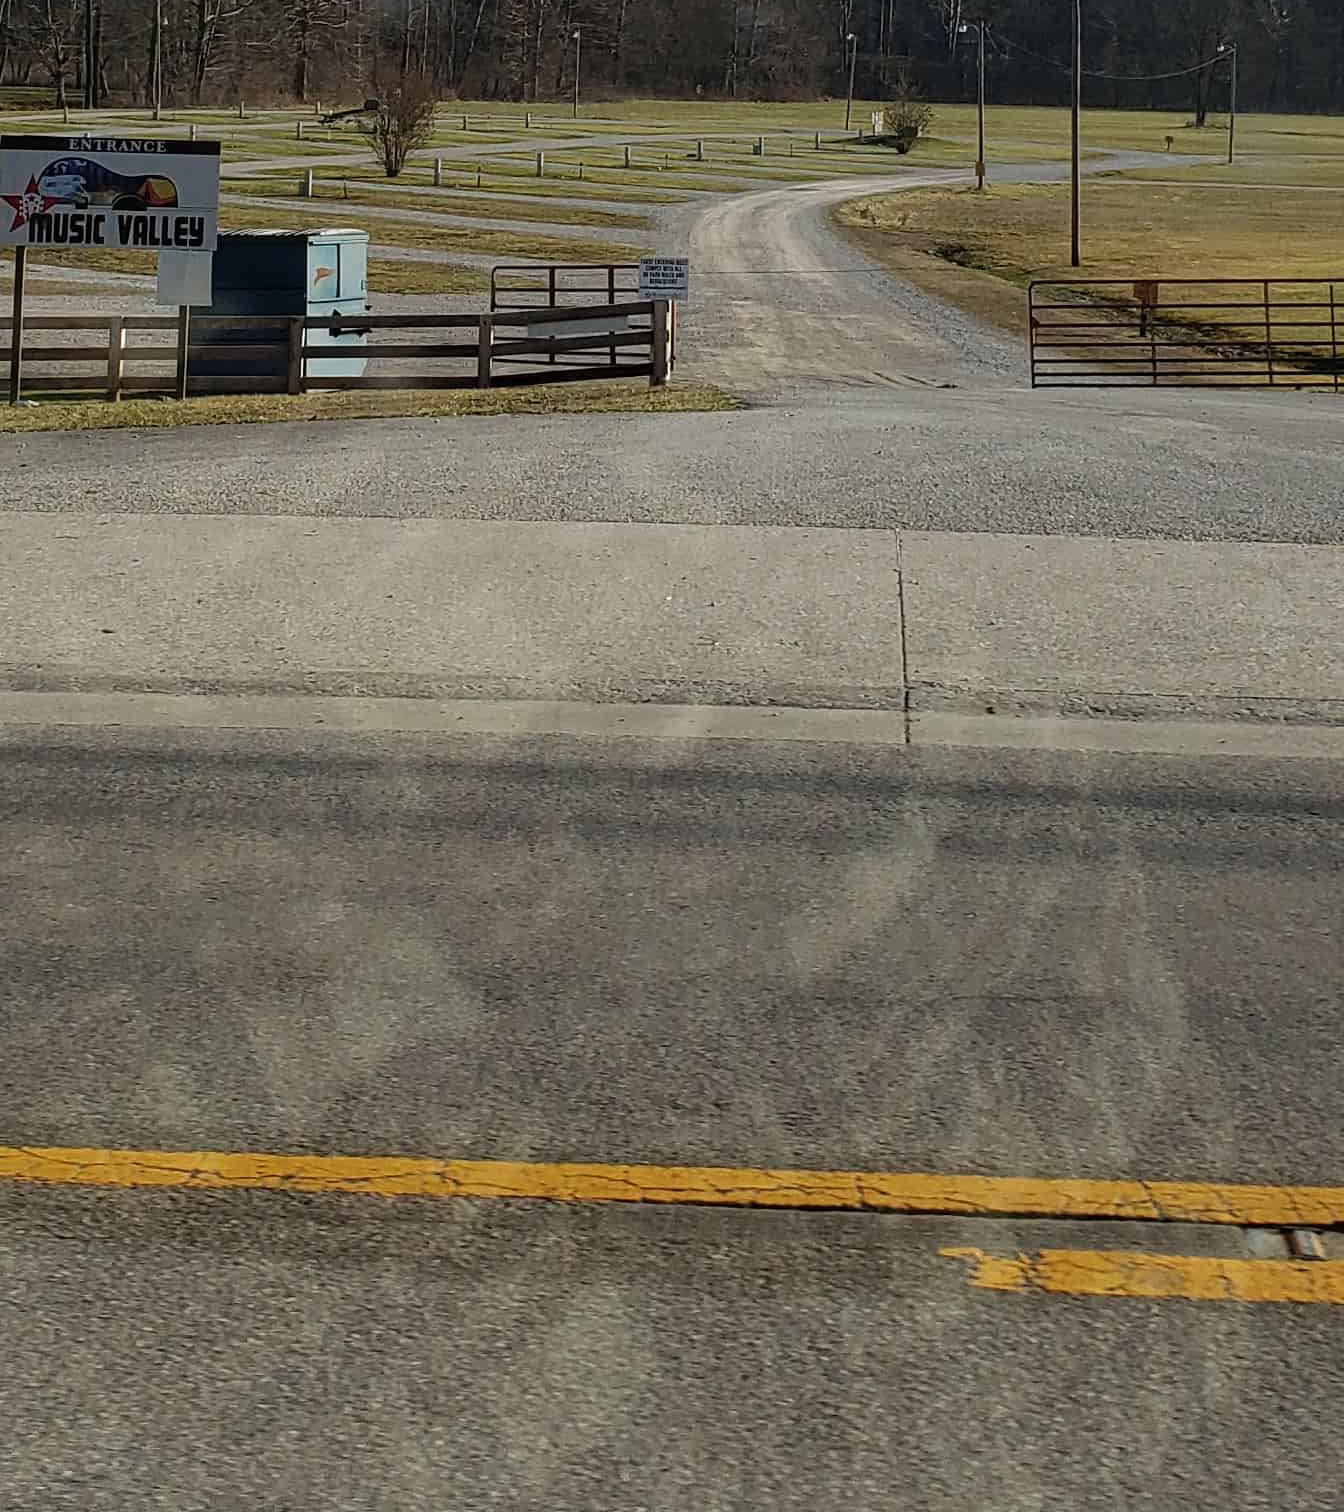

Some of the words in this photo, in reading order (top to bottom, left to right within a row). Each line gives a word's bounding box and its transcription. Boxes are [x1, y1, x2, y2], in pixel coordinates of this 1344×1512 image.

[69, 138, 167, 153] ENTRANCE
[28, 212, 106, 245] MUSIC
[117, 214, 205, 247] VALLEY
